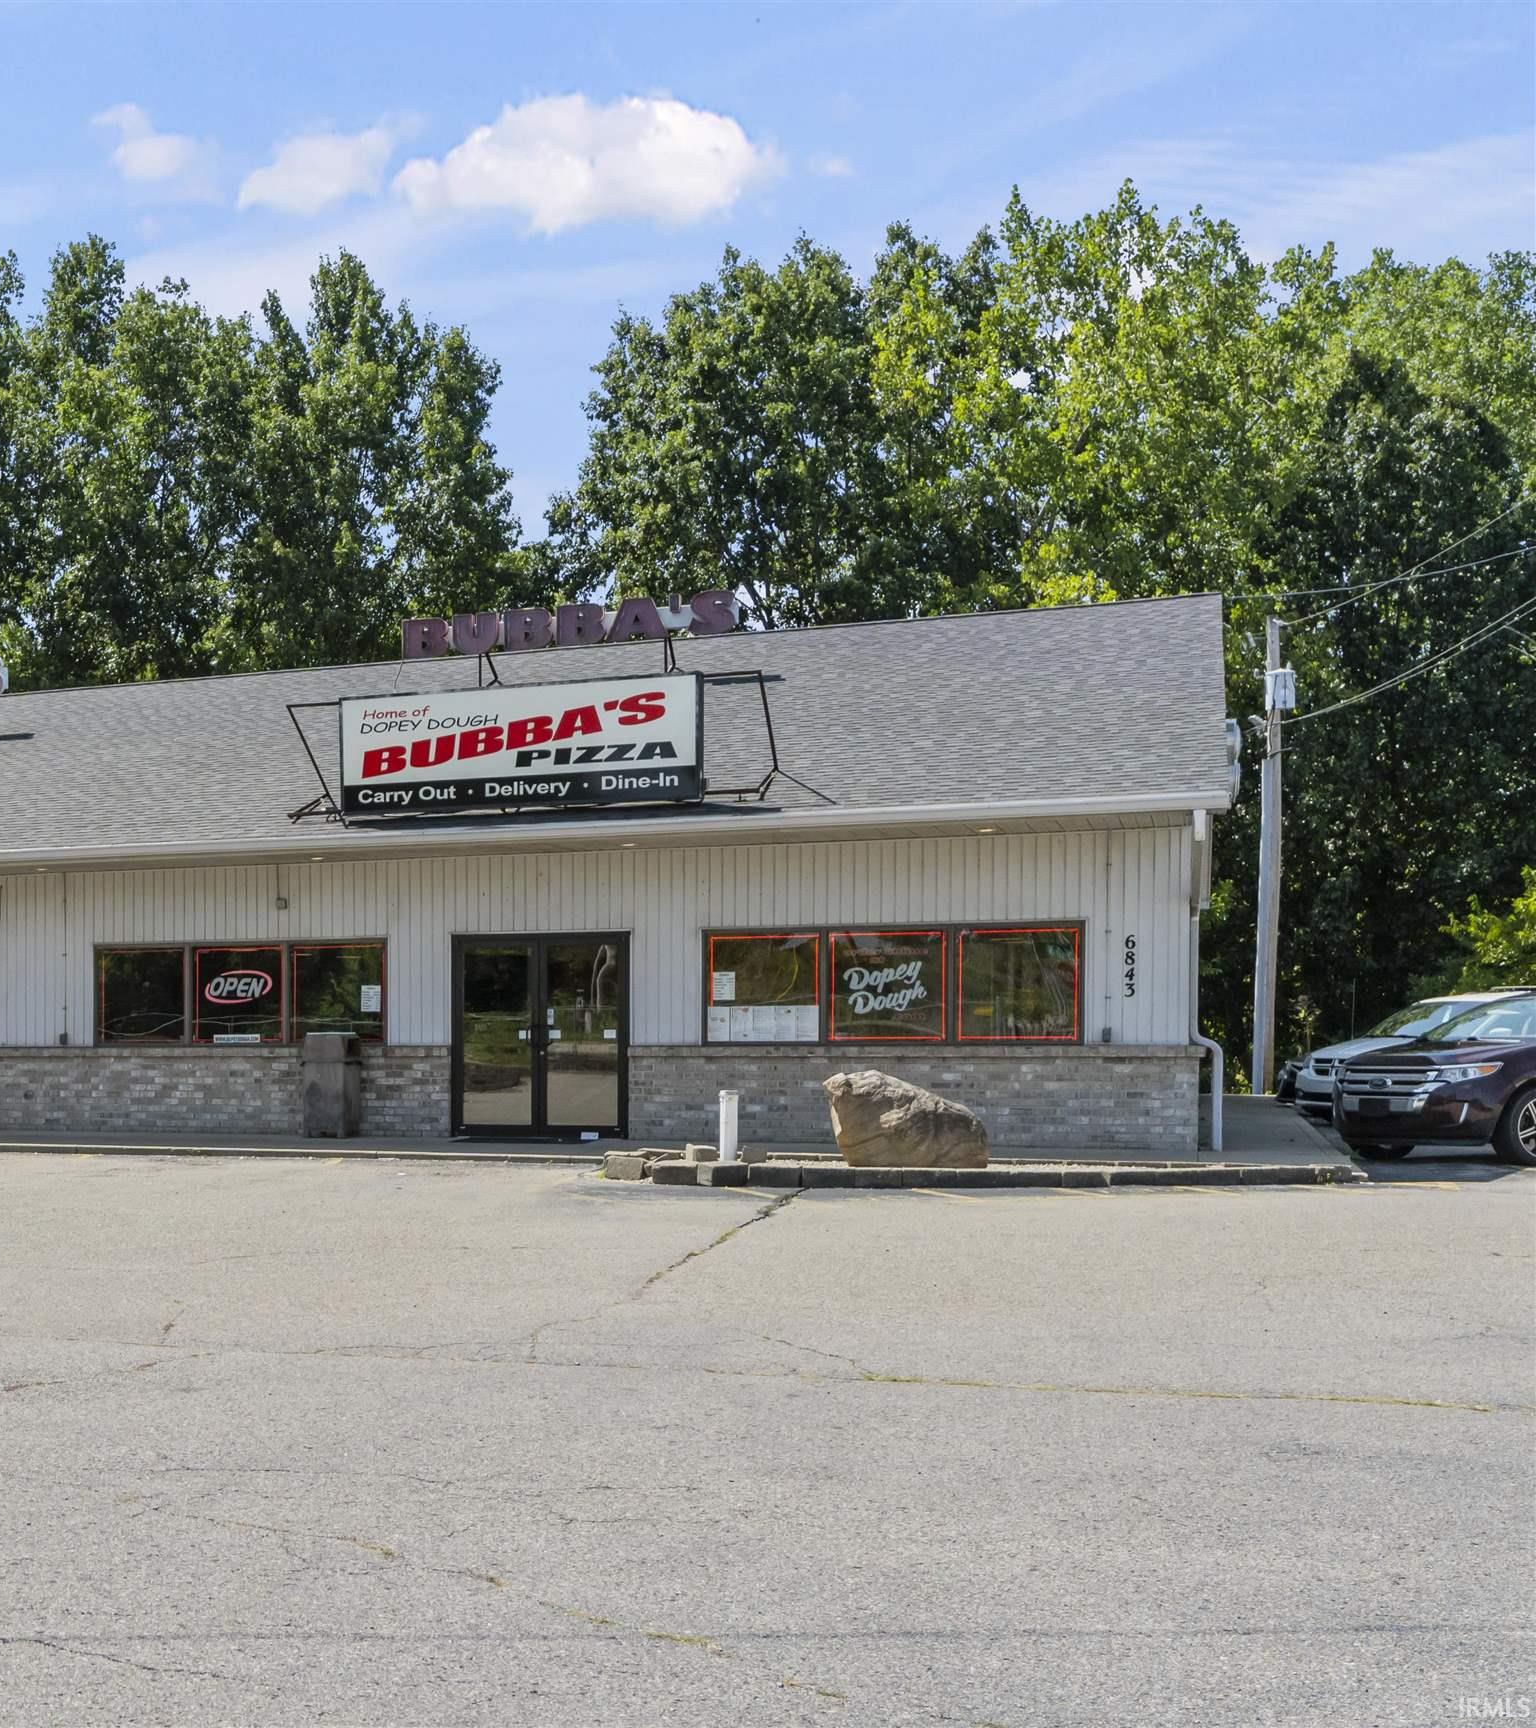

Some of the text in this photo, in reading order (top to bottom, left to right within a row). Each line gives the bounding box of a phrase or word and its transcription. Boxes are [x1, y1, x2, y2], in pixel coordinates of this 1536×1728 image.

[402, 590, 740, 660] BUBBA'S
[360, 714, 499, 734] DOPEY DOUGH
[363, 705, 430, 721] Home of
[362, 691, 666, 779] BUBBA'S
[515, 741, 677, 768] PIZZA
[358, 772, 679, 805] Carry Out Delivery Dine-In
[843, 960, 922, 993] Dopey
[1124, 934, 1136, 998] 6843
[209, 976, 265, 998] OPEN
[848, 980, 927, 1014] Dough
